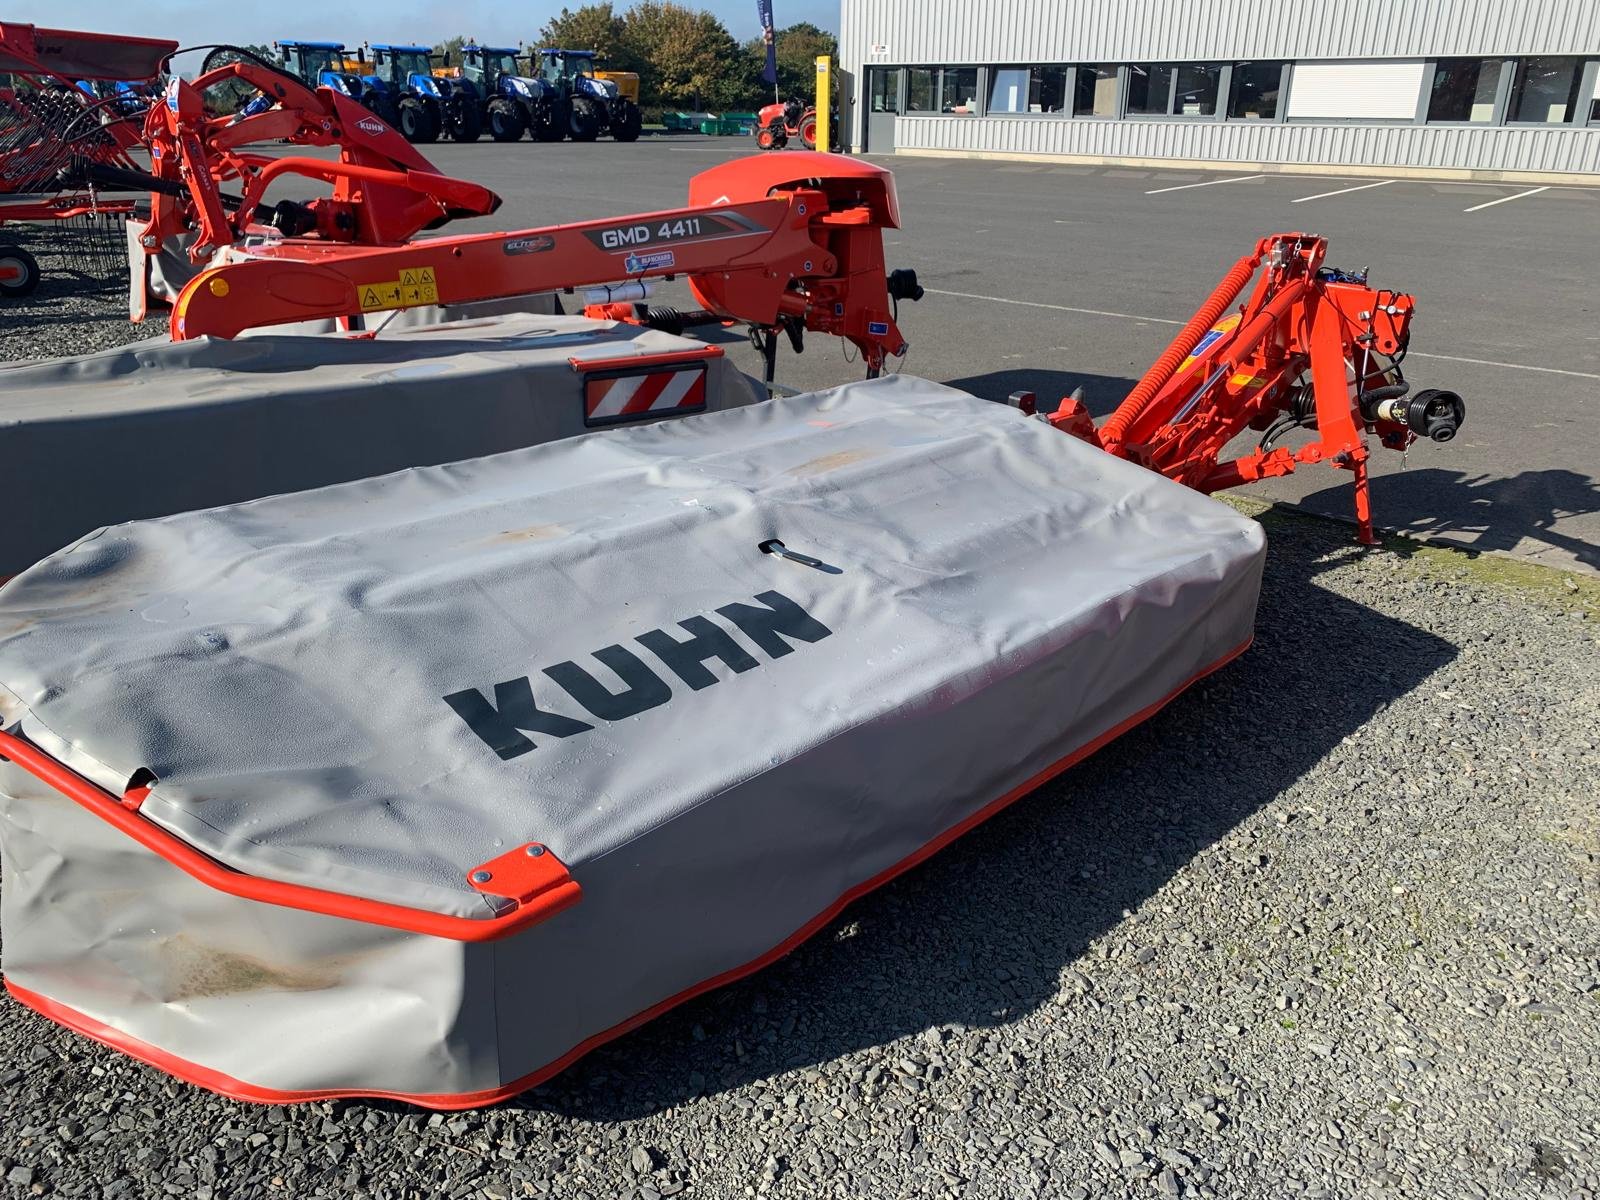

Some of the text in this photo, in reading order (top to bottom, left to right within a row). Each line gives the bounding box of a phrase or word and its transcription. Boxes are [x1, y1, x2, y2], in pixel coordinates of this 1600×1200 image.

[359, 121, 385, 132] KUHN
[601, 218, 701, 248] GMD 4411
[442, 588, 833, 761] KUHN
